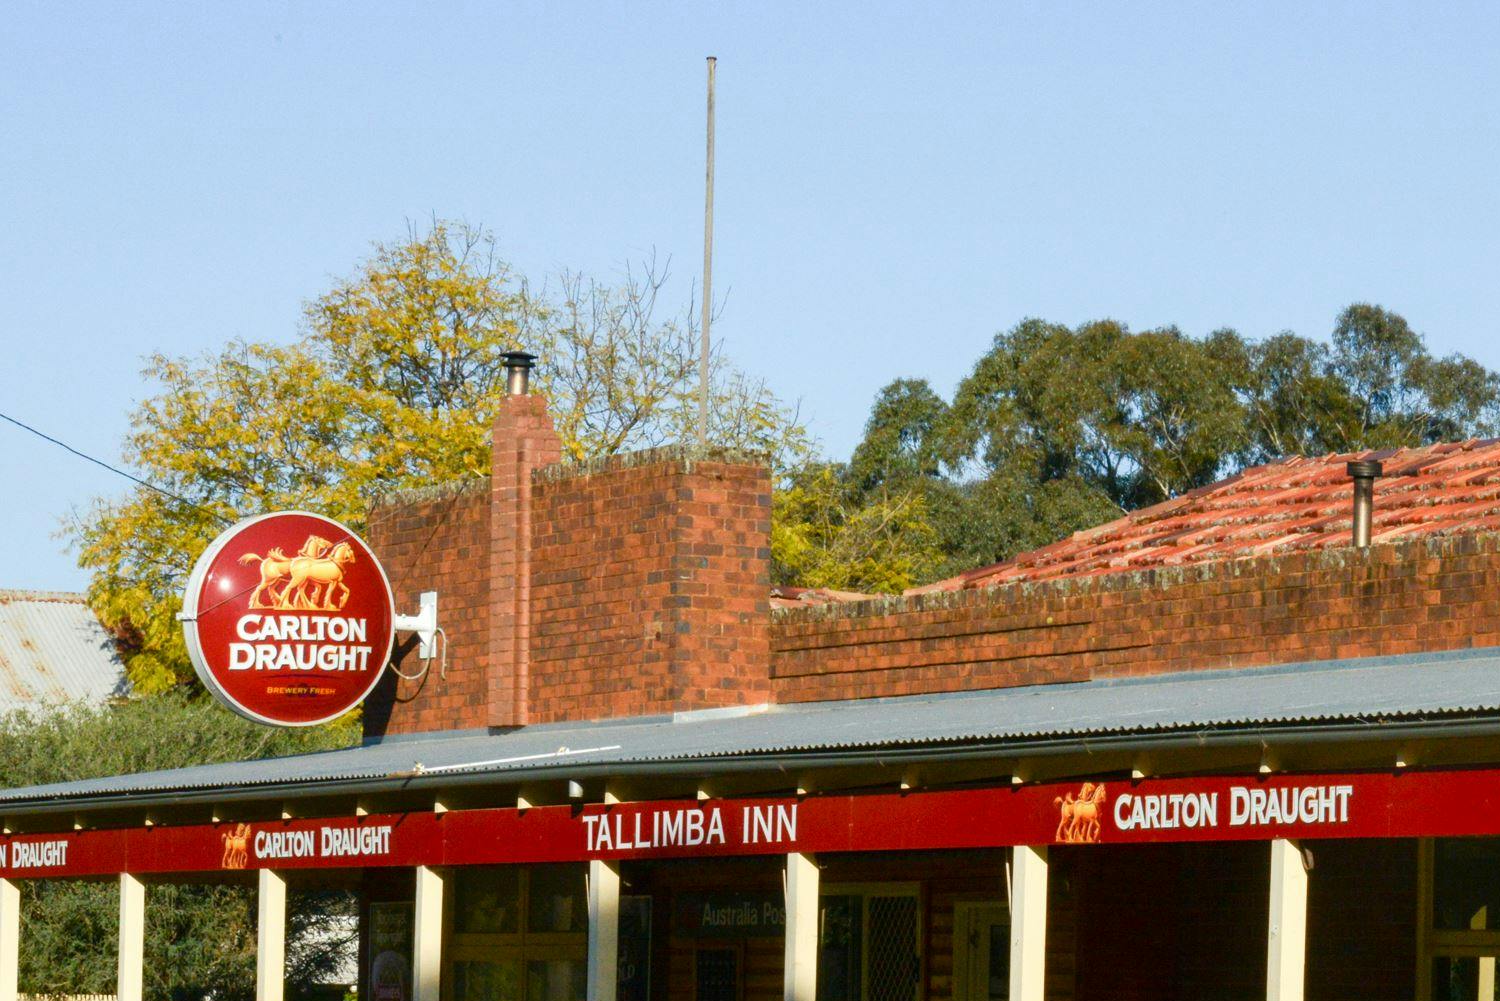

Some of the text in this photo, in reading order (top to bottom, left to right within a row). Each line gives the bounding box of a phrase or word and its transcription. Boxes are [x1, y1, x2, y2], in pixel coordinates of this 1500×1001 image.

[236, 614, 366, 642] CARLTON
[228, 642, 372, 670] DRAUGHT
[266, 686, 336, 695] BREWERY FRESH
[1113, 785, 1353, 830] CARLTON DRAUGHT
[583, 804, 798, 851] TALLIMBA INN
[12, 840, 69, 869] DRAUGHT
[254, 826, 392, 858] CARLTON DRAUGHT
[702, 901, 758, 926] Australia
